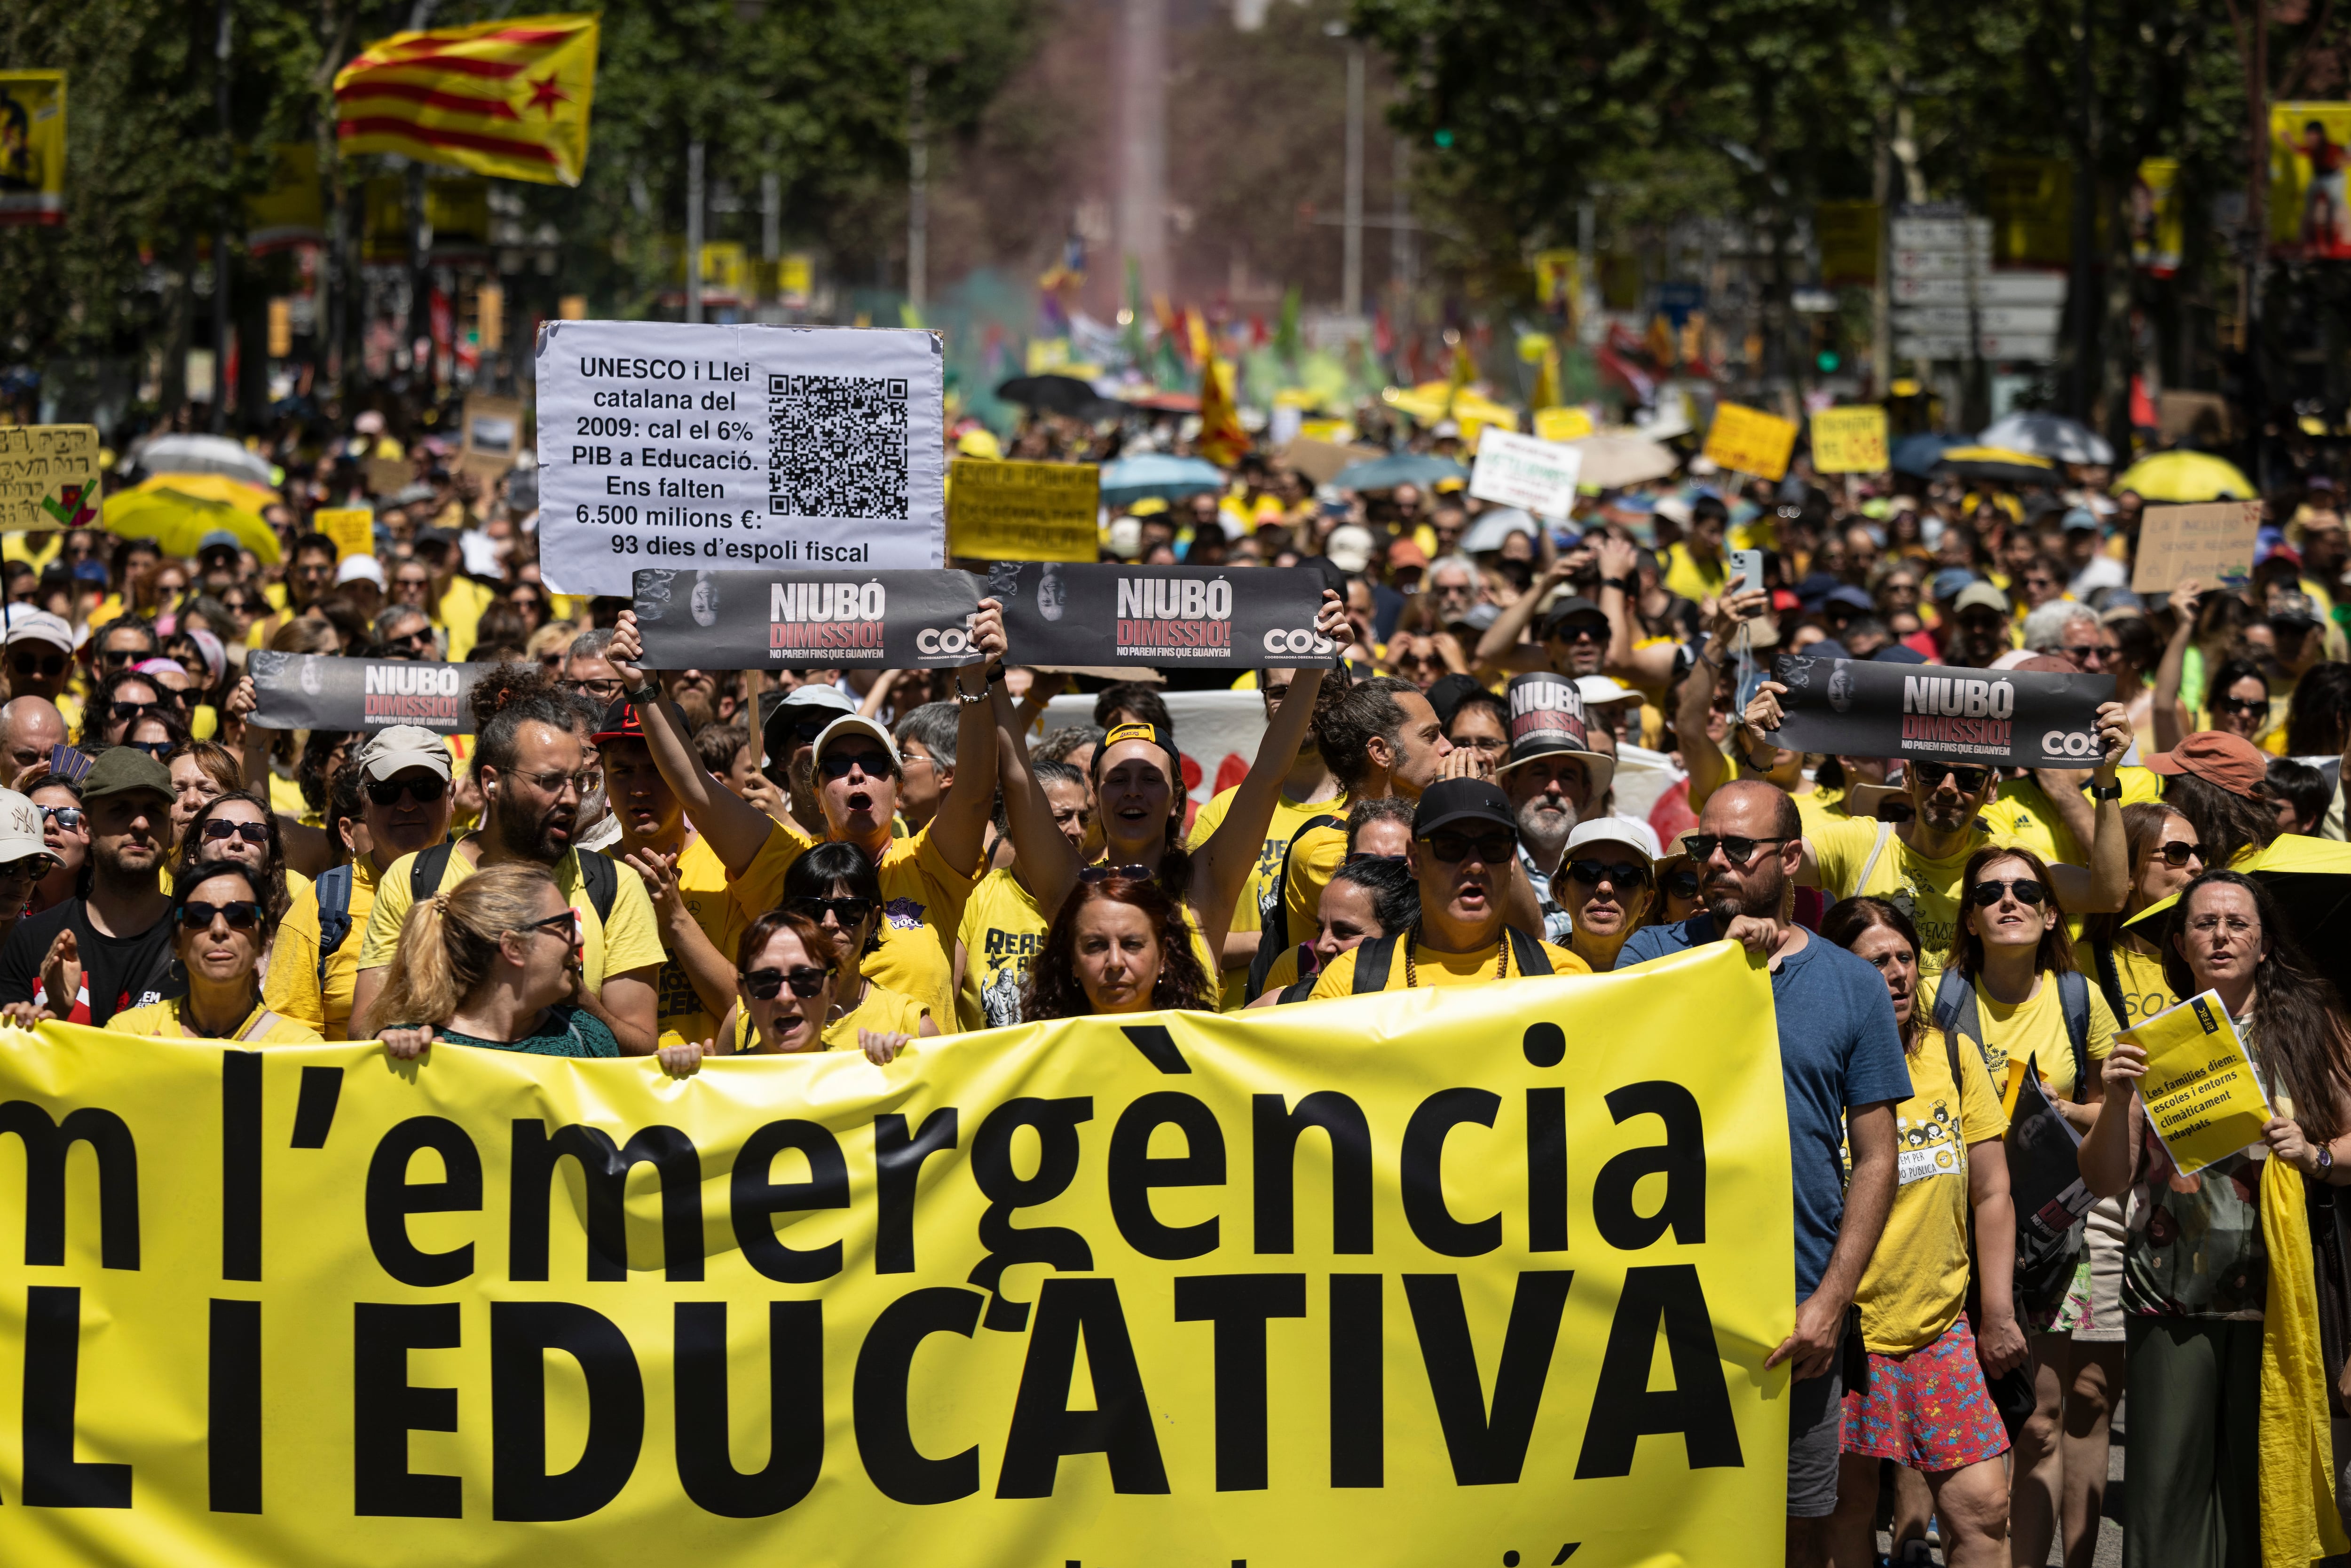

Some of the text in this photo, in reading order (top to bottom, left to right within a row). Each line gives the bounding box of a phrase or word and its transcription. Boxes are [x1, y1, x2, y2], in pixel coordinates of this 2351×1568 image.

[581, 357, 749, 381] UNESCO i Llei
[594, 389, 735, 410] catalana del
[577, 417, 753, 441] 2009: cal el 6%
[573, 446, 758, 471] PIB a Educació.
[607, 476, 724, 498] Ens falten
[576, 504, 761, 529] 6.500 milions €:
[612, 535, 869, 563] 93 dies d'espoli fiscal
[770, 578, 885, 622] NIUBÓ
[1118, 575, 1232, 620] NIUBÓ
[770, 619, 884, 647] DIMISSIÓ!
[1117, 618, 1231, 646] DIMISSIÓ!
[1263, 629, 1332, 654] COS
[770, 649, 884, 660] NO PAREM FINS QUE GUANYEM
[1117, 647, 1231, 658] NO PAREM FINS QUE GUANYEM
[365, 665, 459, 696] NIUBÓ
[1903, 676, 2014, 719] NIUBÓ
[365, 715, 458, 726] NO PAREM FINS QUE GUANYEM
[1902, 714, 2012, 745] DIMISSIÓ!
[1901, 740, 2010, 756] NO PAREM FINS QUE GUANYEM
[2042, 731, 2106, 756] COS
[2145, 1055, 2237, 1100] Les famílies diem:
[2154, 1071, 2237, 1113] escoles i entorns
[2160, 1090, 2232, 1128] climàticament
[2168, 1118, 2211, 1142] adaptats
[1909, 1163, 1937, 1177] PÚBLICA
[1912, 1152, 1925, 1163] PER
[222, 1022, 1707, 1332] l'emergència
[208, 1298, 262, 1514] I
[354, 1264, 1745, 1522] EDUCATIVA
